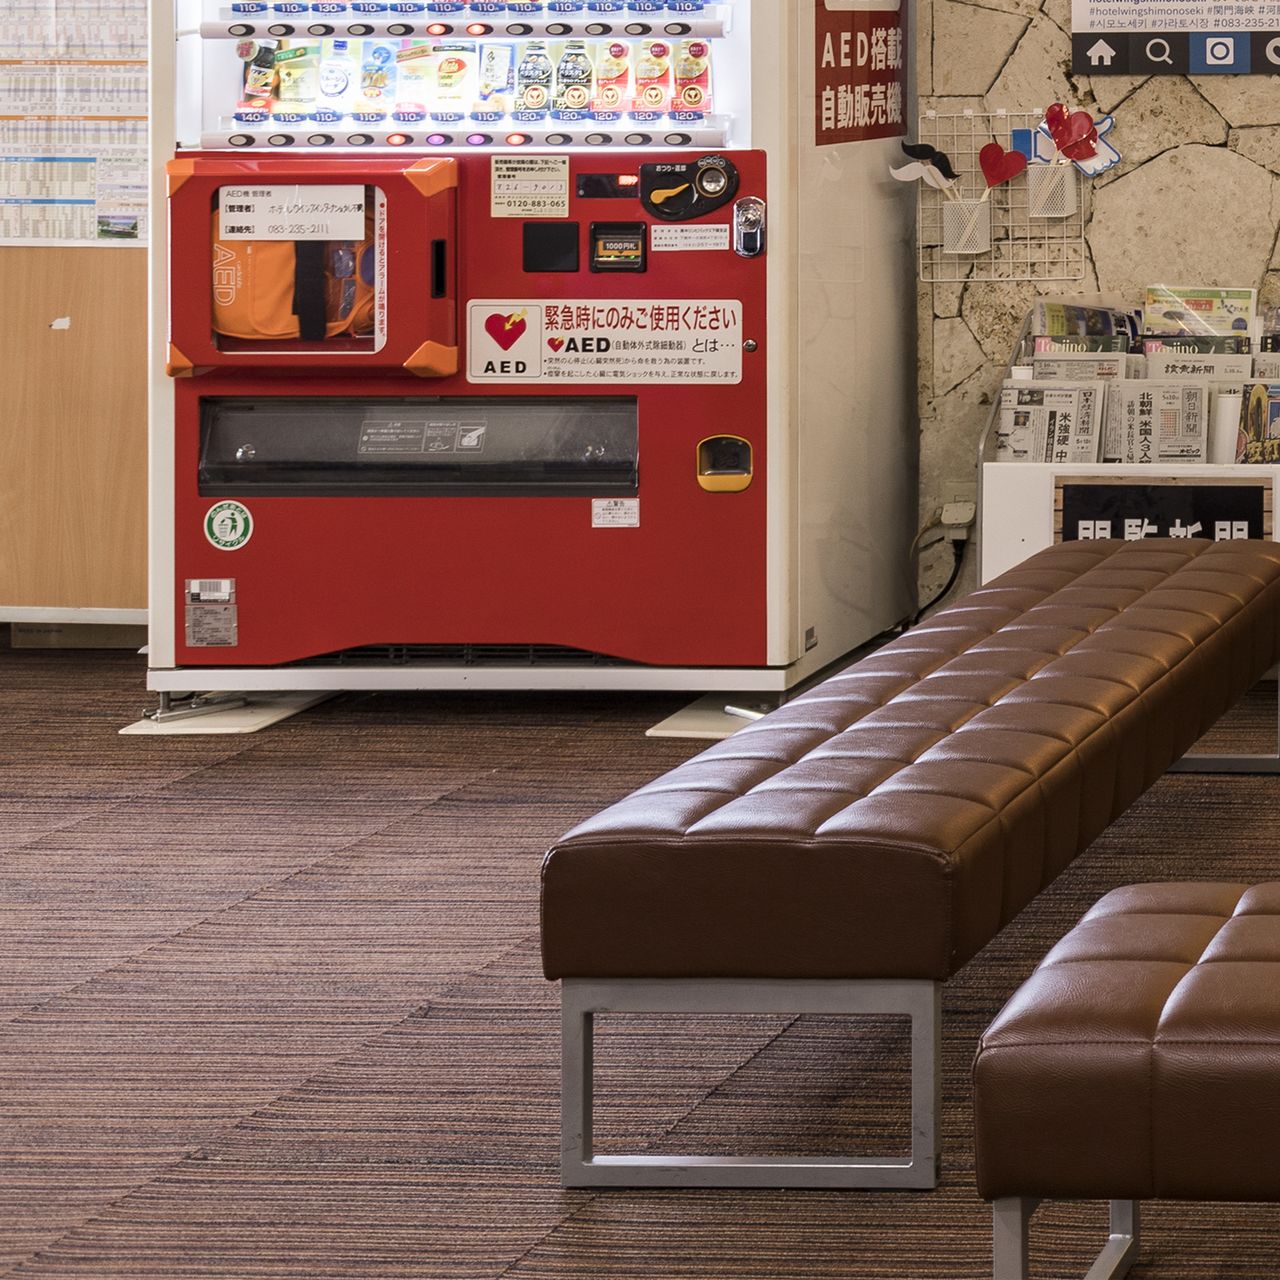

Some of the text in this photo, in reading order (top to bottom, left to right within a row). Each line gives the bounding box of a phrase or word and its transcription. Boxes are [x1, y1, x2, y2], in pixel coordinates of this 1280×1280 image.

[1089, 5, 1204, 17] #hotelwingshimonoseki
[1207, 5, 1255, 16] #関門海峡
[1089, 18, 1147, 29] #시모노세키
[1151, 18, 1209, 29] #가라토시장
[821, 25, 903, 71] AED搭載
[821, 81, 903, 131] 自動販売機
[252, 190, 272, 198] 管理者
[268, 223, 330, 234] 083-235-2111
[606, 242, 637, 250] 1000円札
[213, 243, 238, 307] AED
[544, 305, 737, 331] 緊急時にのみご使用ください
[484, 361, 528, 374] AED
